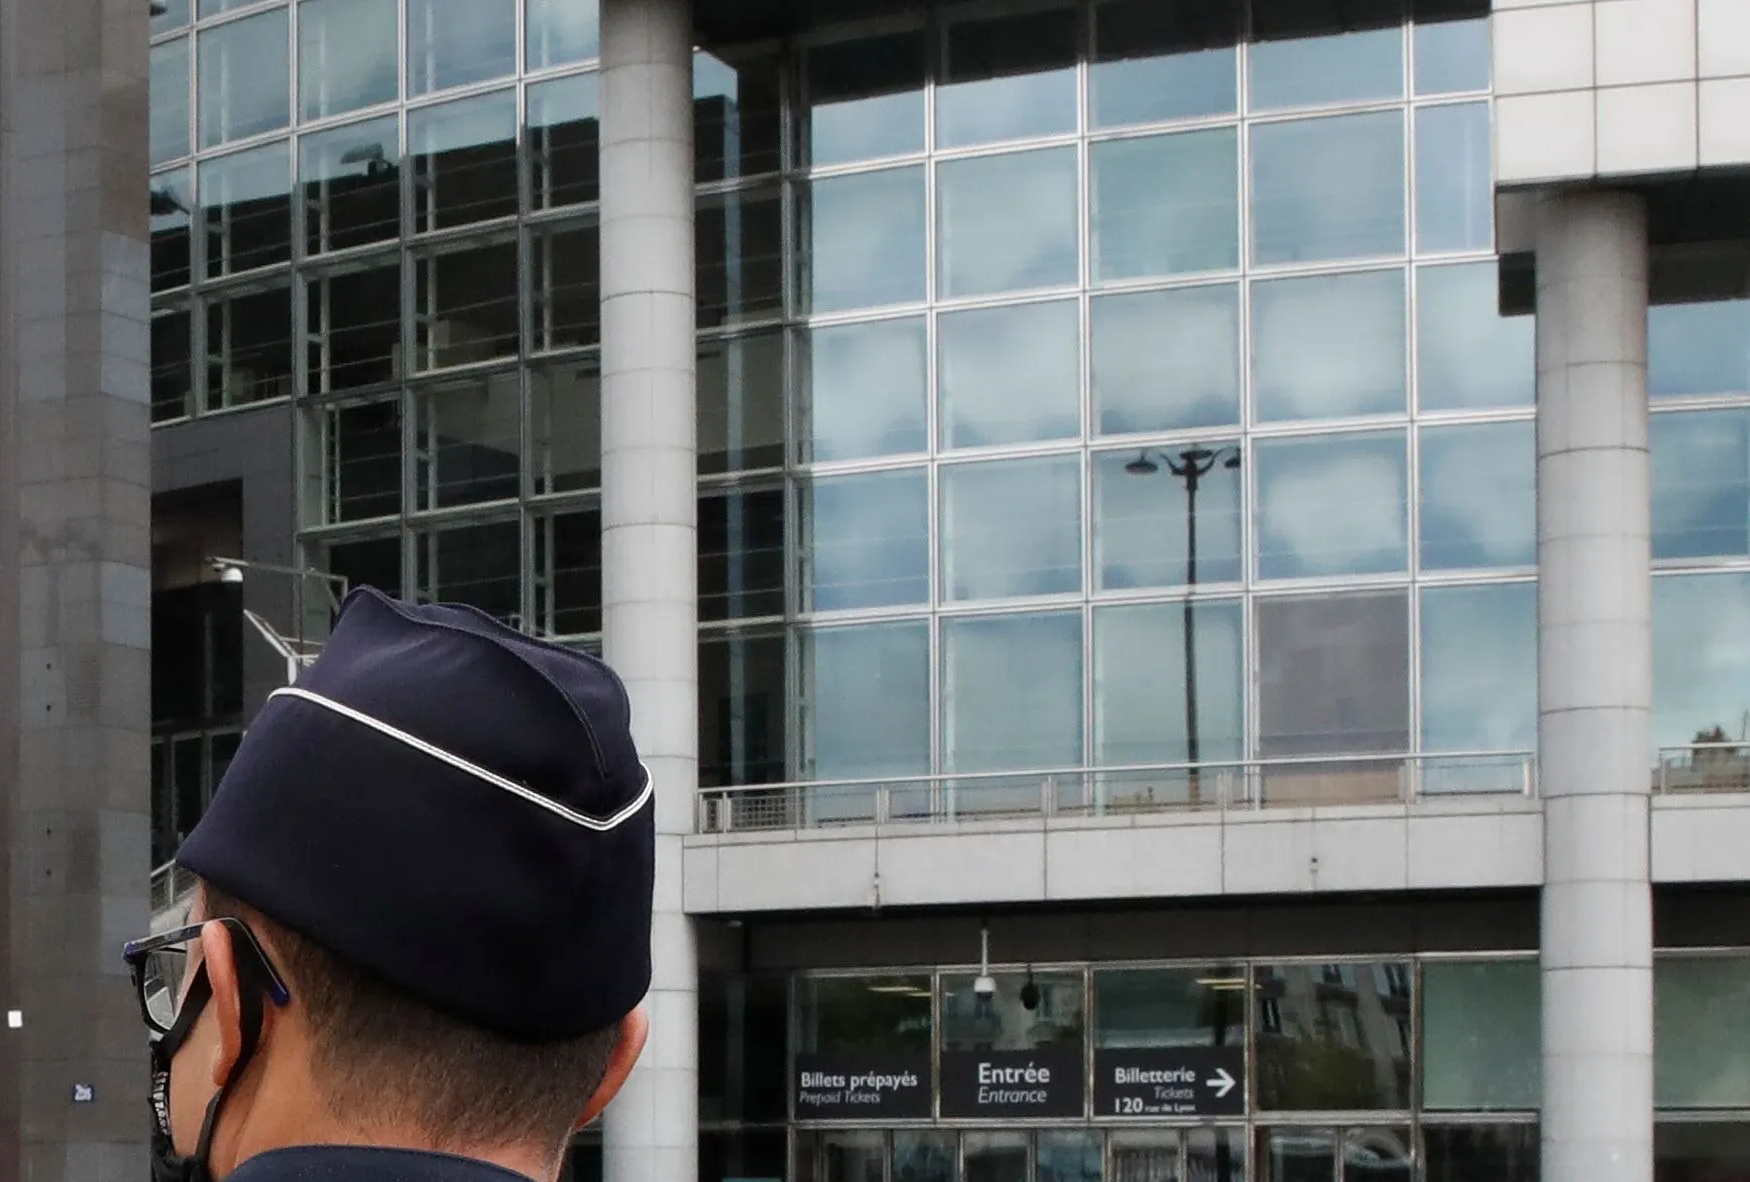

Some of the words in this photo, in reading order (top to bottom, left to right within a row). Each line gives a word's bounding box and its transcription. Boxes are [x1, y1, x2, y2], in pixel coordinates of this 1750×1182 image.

[801, 1072, 846, 1088] Billets
[850, 1070, 918, 1091] prépayés
[978, 1061, 1050, 1084] Entrée
[1114, 1066, 1196, 1084] Billetterie
[799, 1091, 841, 1106] Prepaid
[844, 1091, 881, 1104] Tickets
[978, 1086, 1048, 1104] Entrance
[1153, 1085, 1195, 1100] Tickets
[1115, 1097, 1144, 1113] 120
